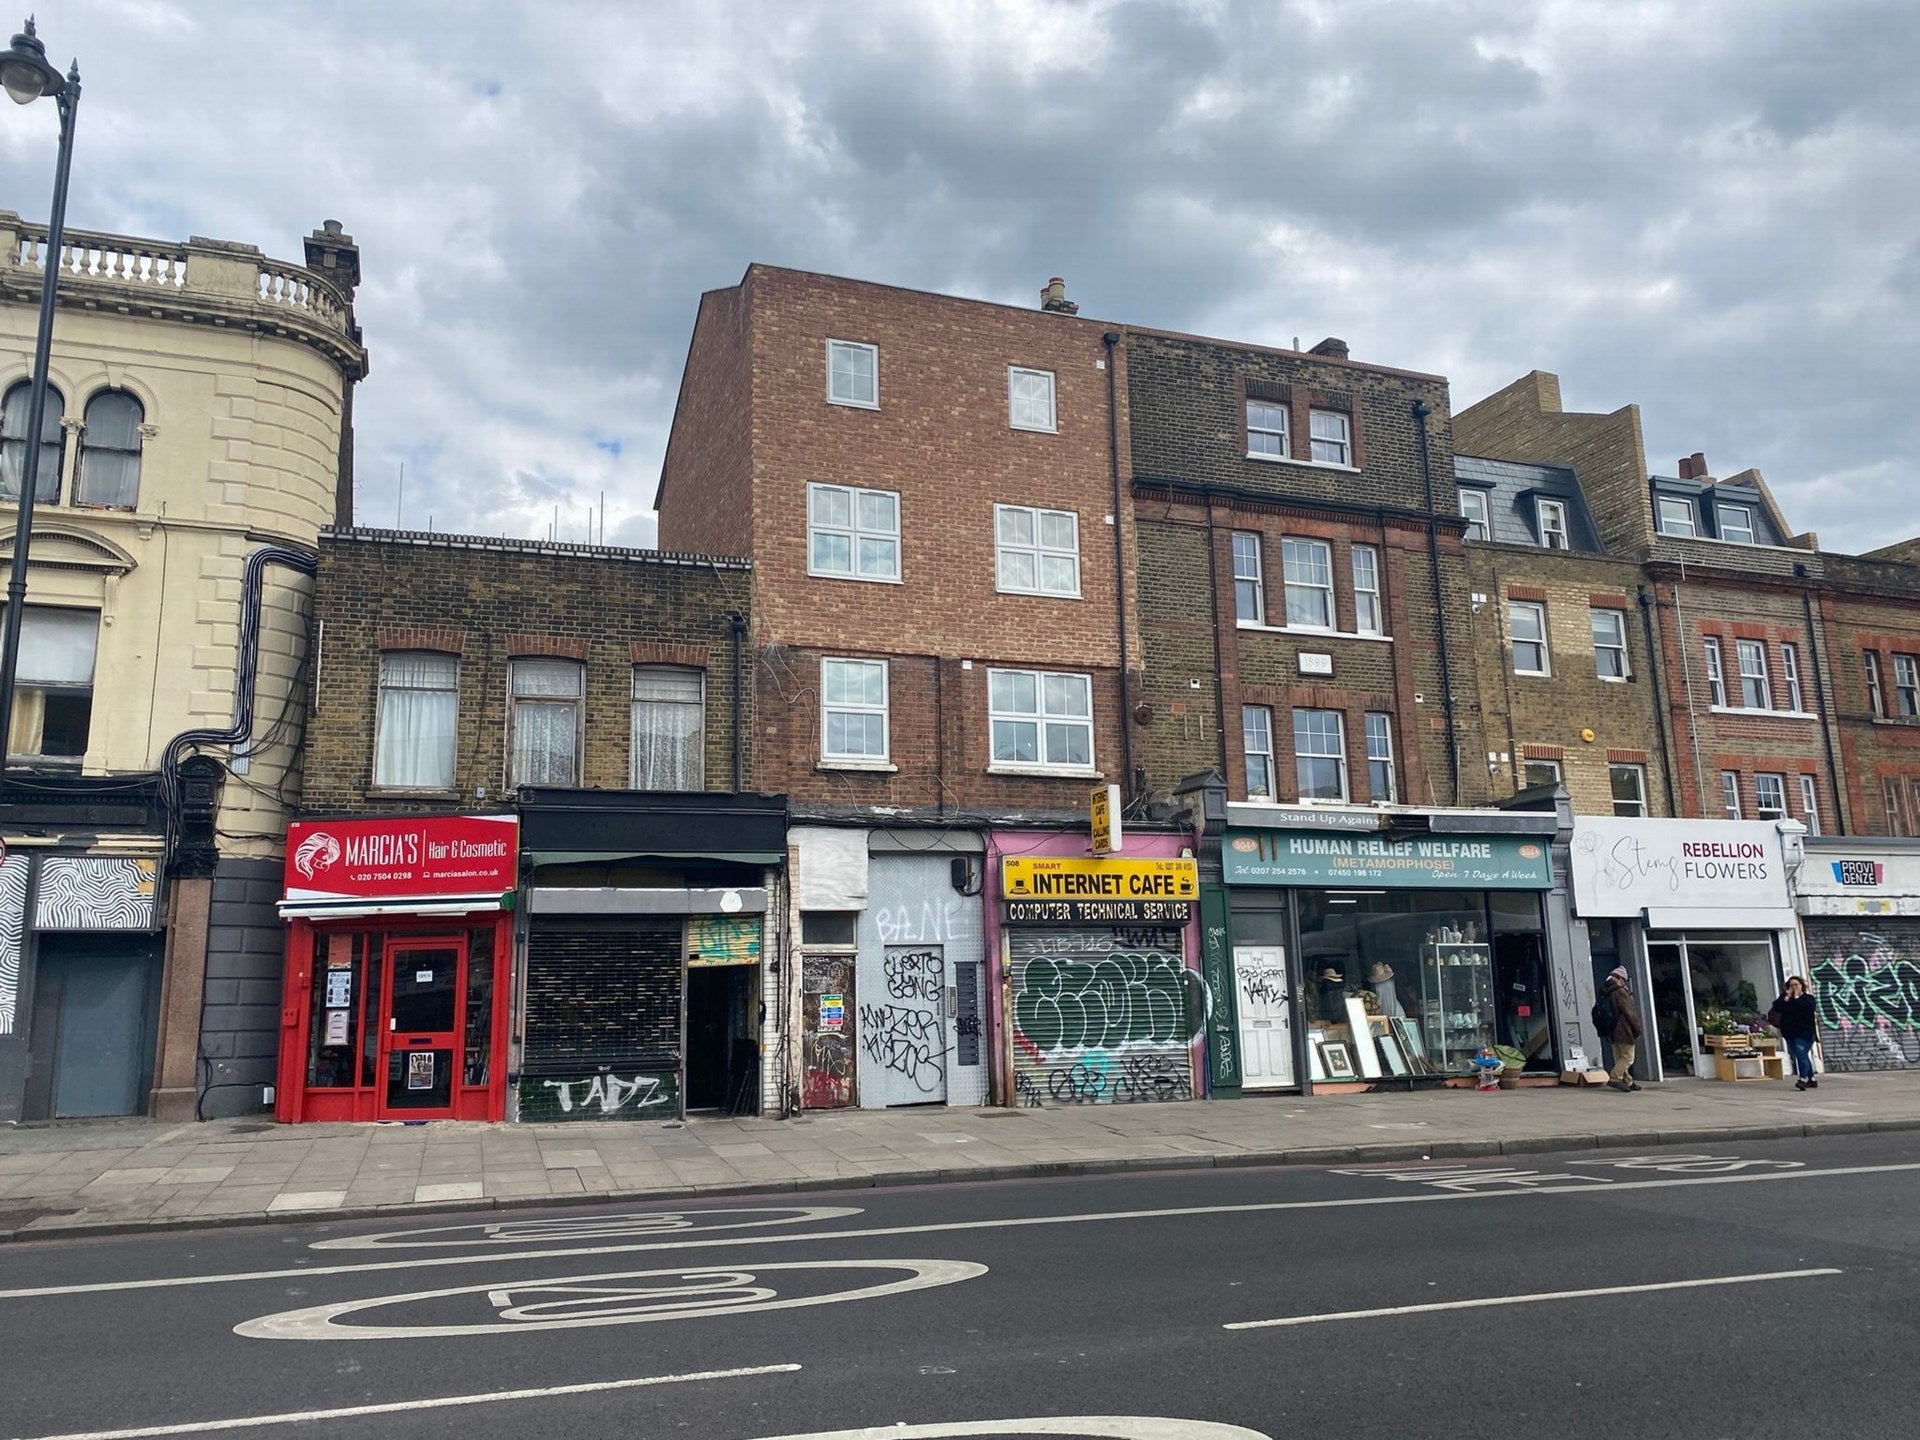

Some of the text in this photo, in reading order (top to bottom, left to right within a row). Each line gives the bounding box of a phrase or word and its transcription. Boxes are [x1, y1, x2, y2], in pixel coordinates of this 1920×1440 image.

[1280, 813, 1316, 822] Stand
[1320, 814, 1336, 824] Up
[345, 834, 507, 867] MARCIA'S Hair & Cosmetic
[1289, 838, 1491, 858] HUMAN RELIEF WELFARE
[1682, 842, 1764, 858] REBELLION
[1332, 857, 1455, 870] (METAMORPHOSE)
[1841, 861, 1873, 873] PROVI
[357, 873, 372, 881] 020
[393, 872, 412, 880] 0298
[433, 869, 499, 878] marciasalon.co.uk
[1251, 867, 1270, 875] 0207
[1432, 870, 1458, 880] Open
[1464, 870, 1469, 878] 7
[1472, 871, 1498, 881] Days
[1511, 871, 1537, 879] Week
[1684, 862, 1767, 879] FLOWERS
[1033, 874, 1174, 895] INTERNET CAFE
[1843, 873, 1876, 884] DENZE
[1009, 902, 1188, 920] COMPUTER TECHNICAL SERVICE
